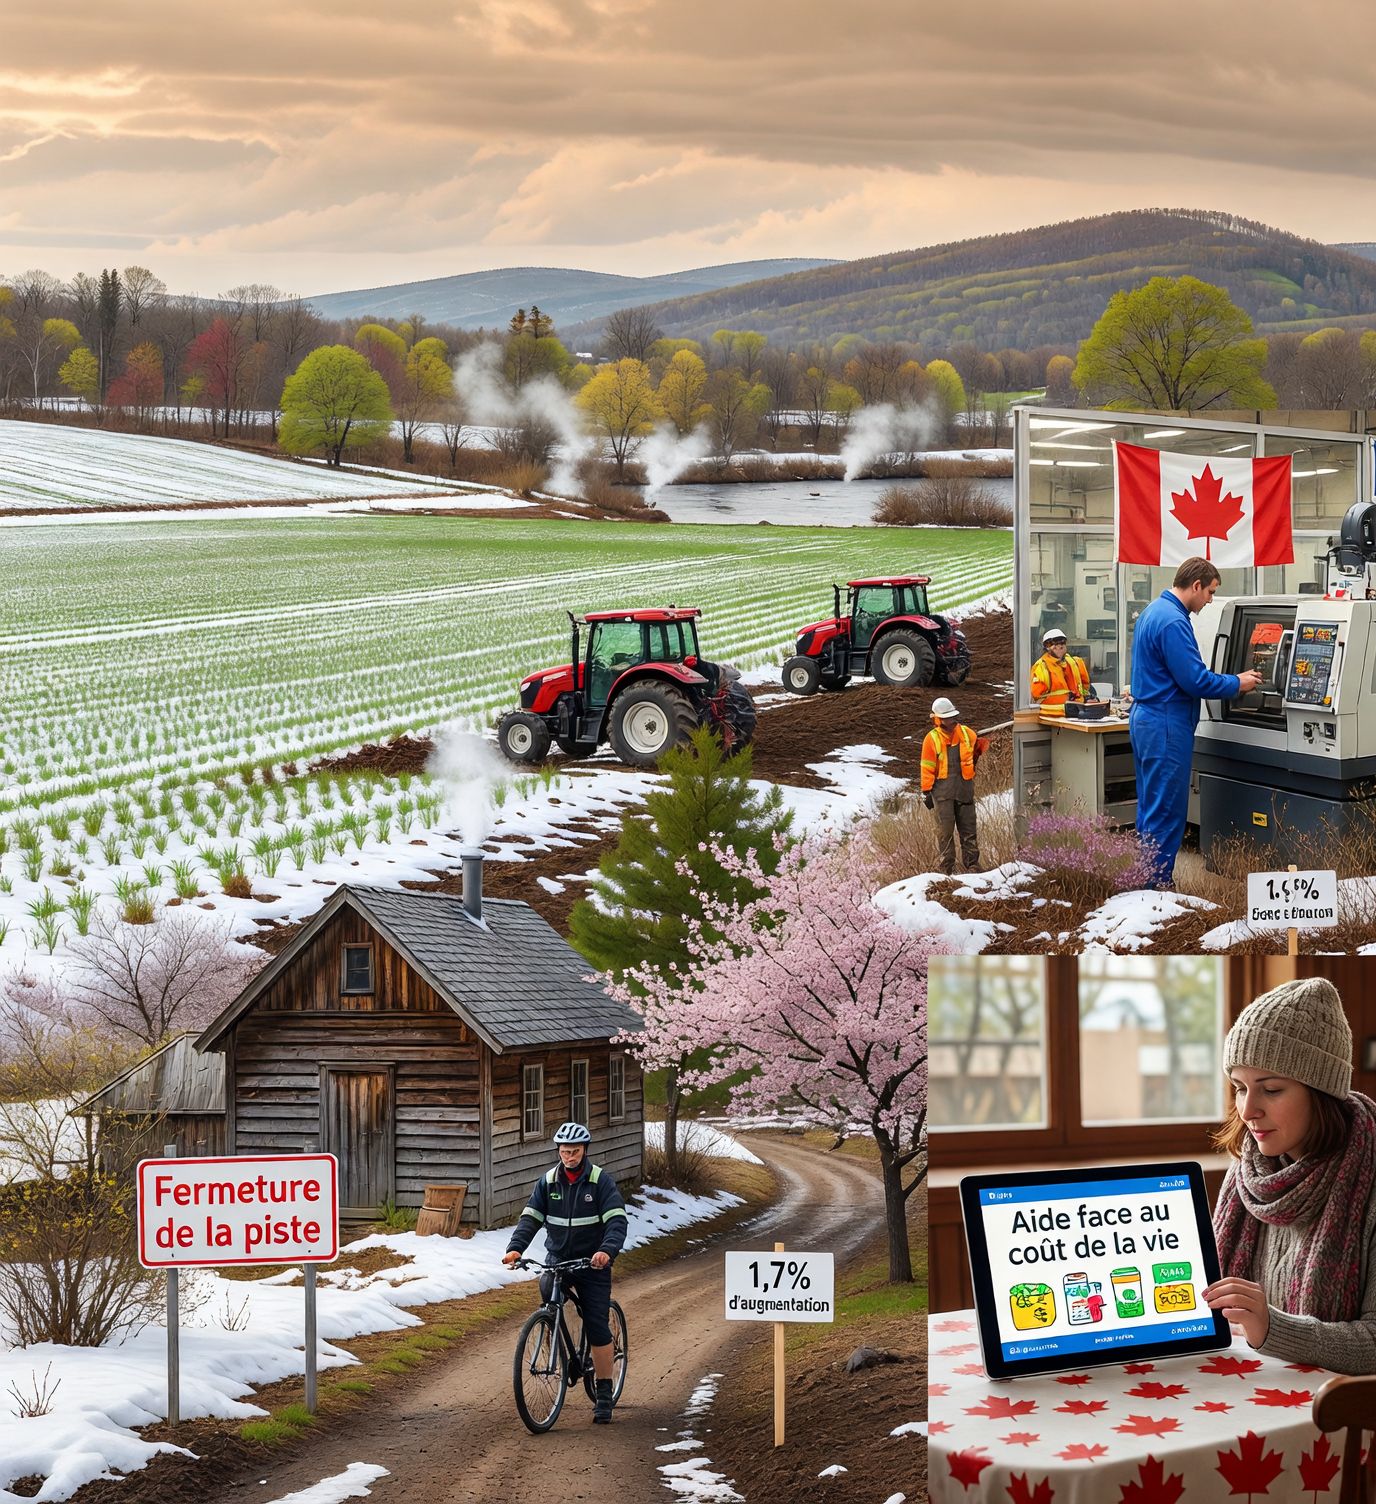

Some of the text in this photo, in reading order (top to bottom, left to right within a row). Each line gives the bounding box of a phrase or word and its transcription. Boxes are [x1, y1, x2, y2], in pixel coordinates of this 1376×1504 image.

[155, 1175, 320, 1206] Fermeture
[155, 1214, 321, 1254] de la piste
[1011, 1203, 1170, 1234] Aide face au
[1008, 1228, 1179, 1265] coût de la vie
[749, 1261, 811, 1293] 1,7%
[729, 1295, 829, 1314] d'augmentation
